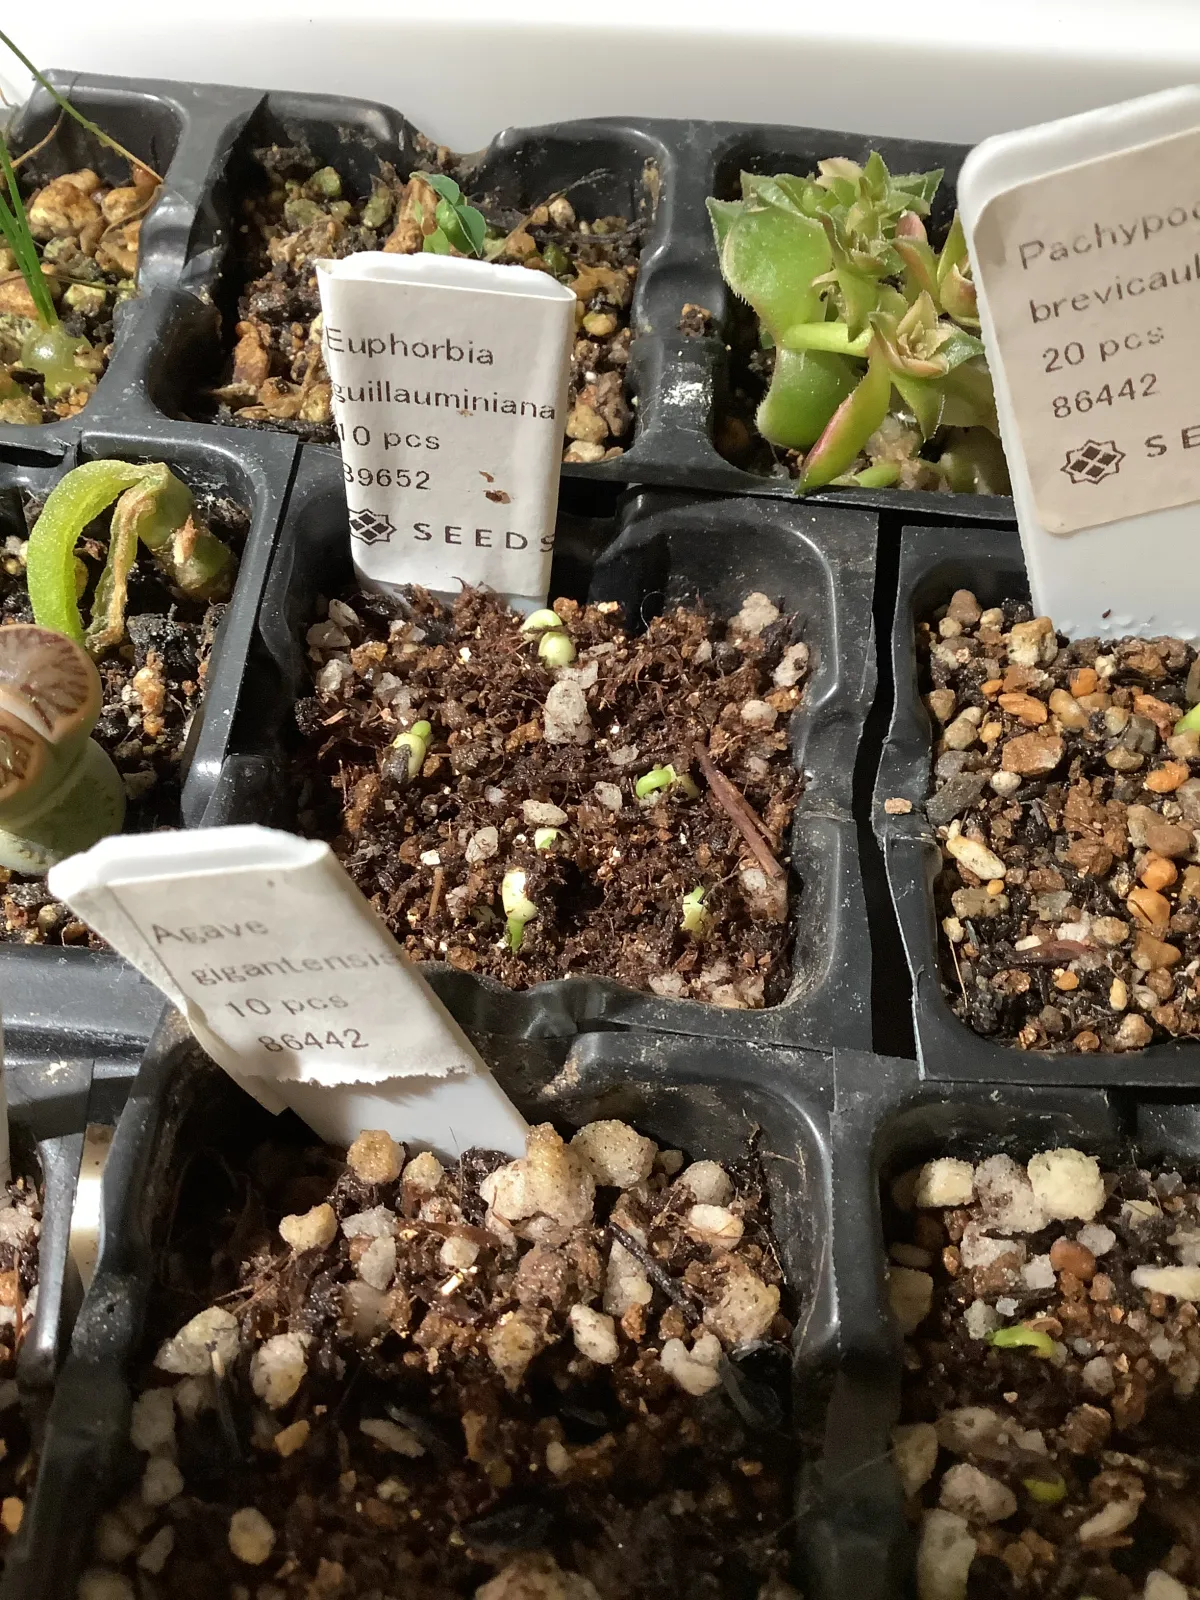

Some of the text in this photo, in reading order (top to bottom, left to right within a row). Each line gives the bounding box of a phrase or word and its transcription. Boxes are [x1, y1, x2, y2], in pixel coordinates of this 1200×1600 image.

[326, 325, 494, 366] Euphorbia
[1042, 326, 1165, 373] 20 pcs
[332, 380, 556, 420] guillauminiana
[1052, 373, 1159, 418] 86442
[383, 431, 441, 450] pcs
[412, 522, 556, 553] SEEDS
[151, 919, 269, 945] Agave
[225, 994, 349, 1018] 10 pcs
[257, 1028, 369, 1053] 86442
